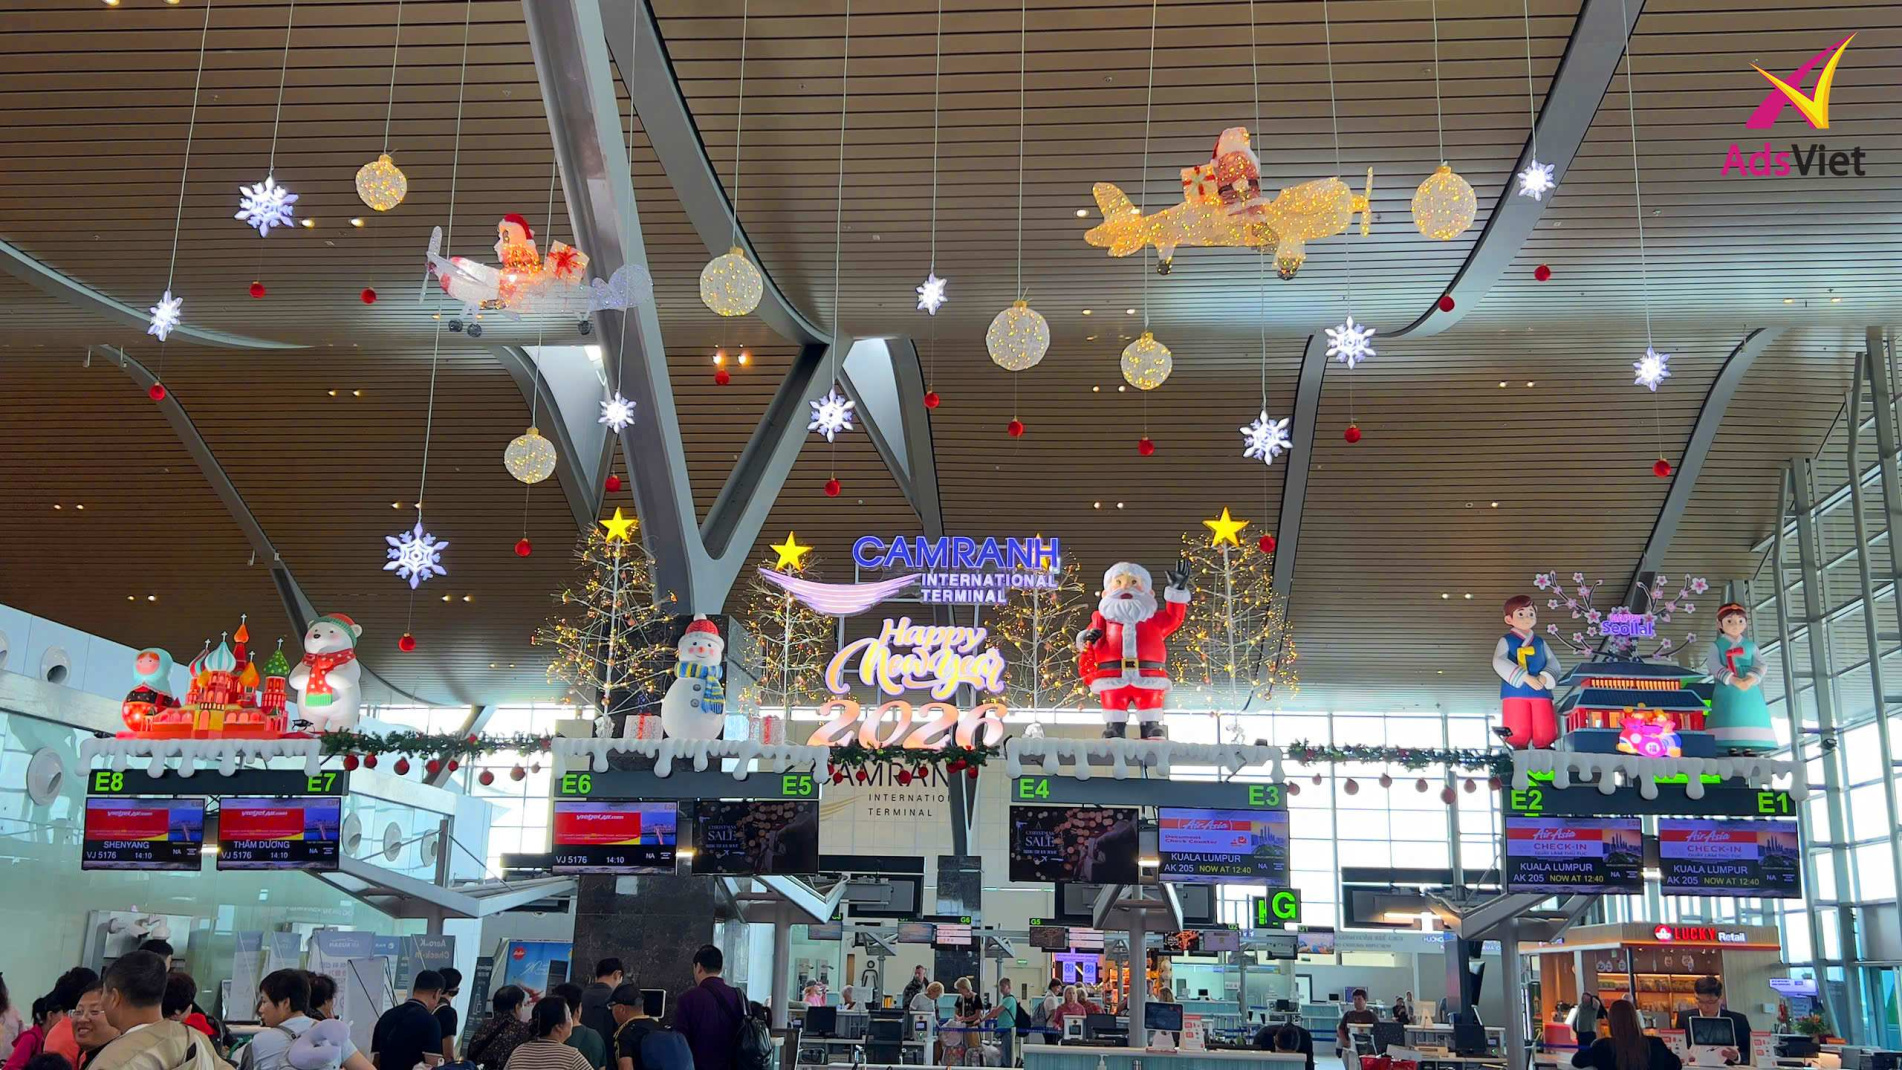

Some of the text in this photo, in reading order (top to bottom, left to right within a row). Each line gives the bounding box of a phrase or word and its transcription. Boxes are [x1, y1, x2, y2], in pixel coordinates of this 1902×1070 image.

[853, 535, 1060, 570] CAMRANH
[921, 573, 1058, 588] INTERNATIONAL
[921, 589, 1007, 604] TERMINAL
[879, 616, 987, 653] Happy
[1602, 621, 1653, 635] Seollal
[807, 700, 1008, 749] 2026
[95, 772, 124, 792] E8
[307, 773, 337, 792] E7
[562, 774, 592, 794] E6
[782, 775, 812, 795] E5
[1020, 778, 1050, 799] E4
[1249, 785, 1280, 806] E3
[1511, 789, 1543, 810] E2
[1757, 792, 1788, 813] E1
[868, 807, 932, 817] TERMINAL
[707, 831, 737, 841] SALE
[1025, 836, 1055, 847] SALE
[103, 841, 150, 849] SHENYANG
[86, 851, 97, 859] VJ
[98, 851, 117, 859] 5176
[1171, 853, 1241, 862] KUALA LUMPUR
[1164, 864, 1177, 872] AK
[1178, 864, 1194, 872] 205
[1232, 866, 1252, 874] 12:40
[1520, 863, 1593, 872] KUALA LUMPUR
[1673, 865, 1749, 874] KUALA LUMPUR
[1513, 874, 1526, 882] AK
[1528, 874, 1545, 882] 205
[1584, 875, 1604, 883] 12:40
[1667, 876, 1680, 884] AK
[1682, 876, 1699, 885] 205
[1703, 877, 1724, 885] NOW
[1739, 878, 1760, 886] 12:40
[1272, 891, 1297, 919] G
[1674, 927, 1745, 942] LUCKY Retail
